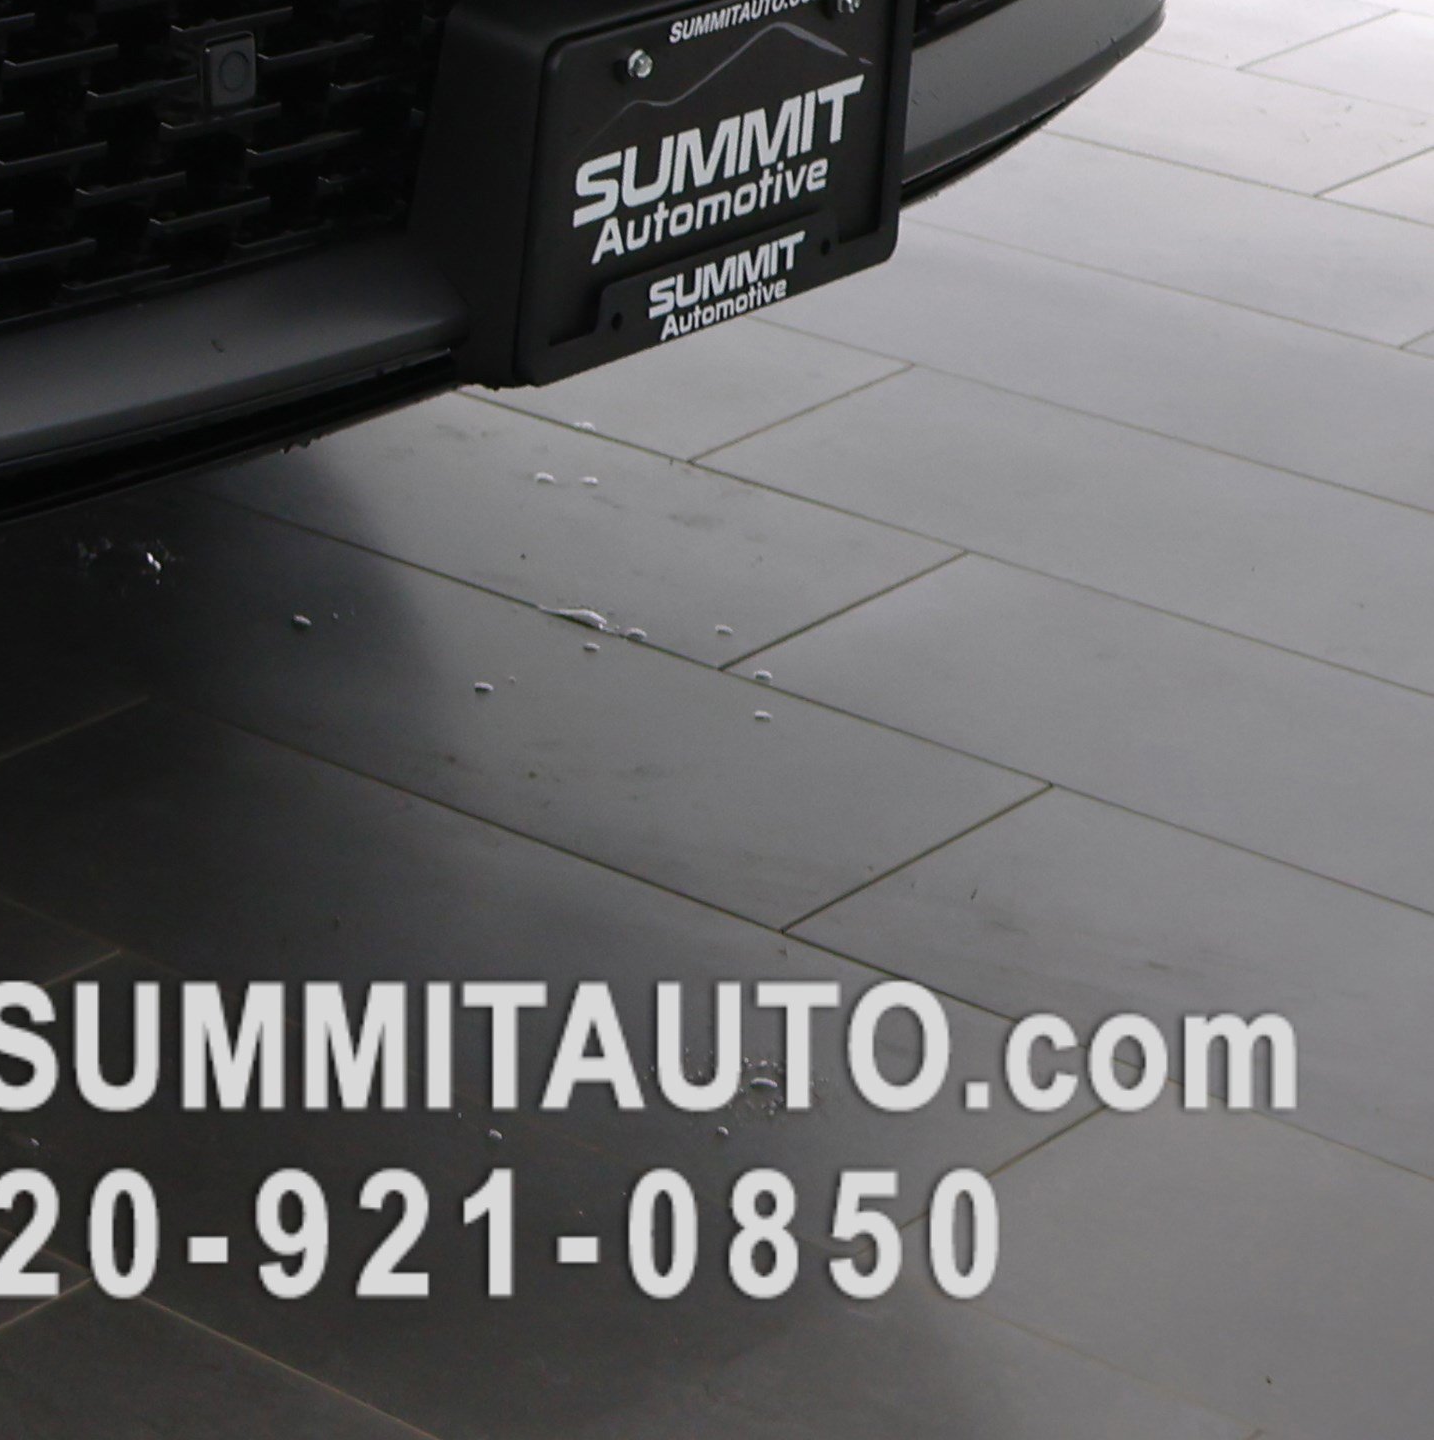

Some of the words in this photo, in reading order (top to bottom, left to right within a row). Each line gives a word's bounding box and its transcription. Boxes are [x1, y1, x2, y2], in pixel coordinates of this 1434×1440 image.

[573, 75, 864, 228] SUMMIT
[591, 157, 829, 264] Automotive
[648, 231, 805, 318] SUMMIT
[660, 277, 787, 341] Automotive
